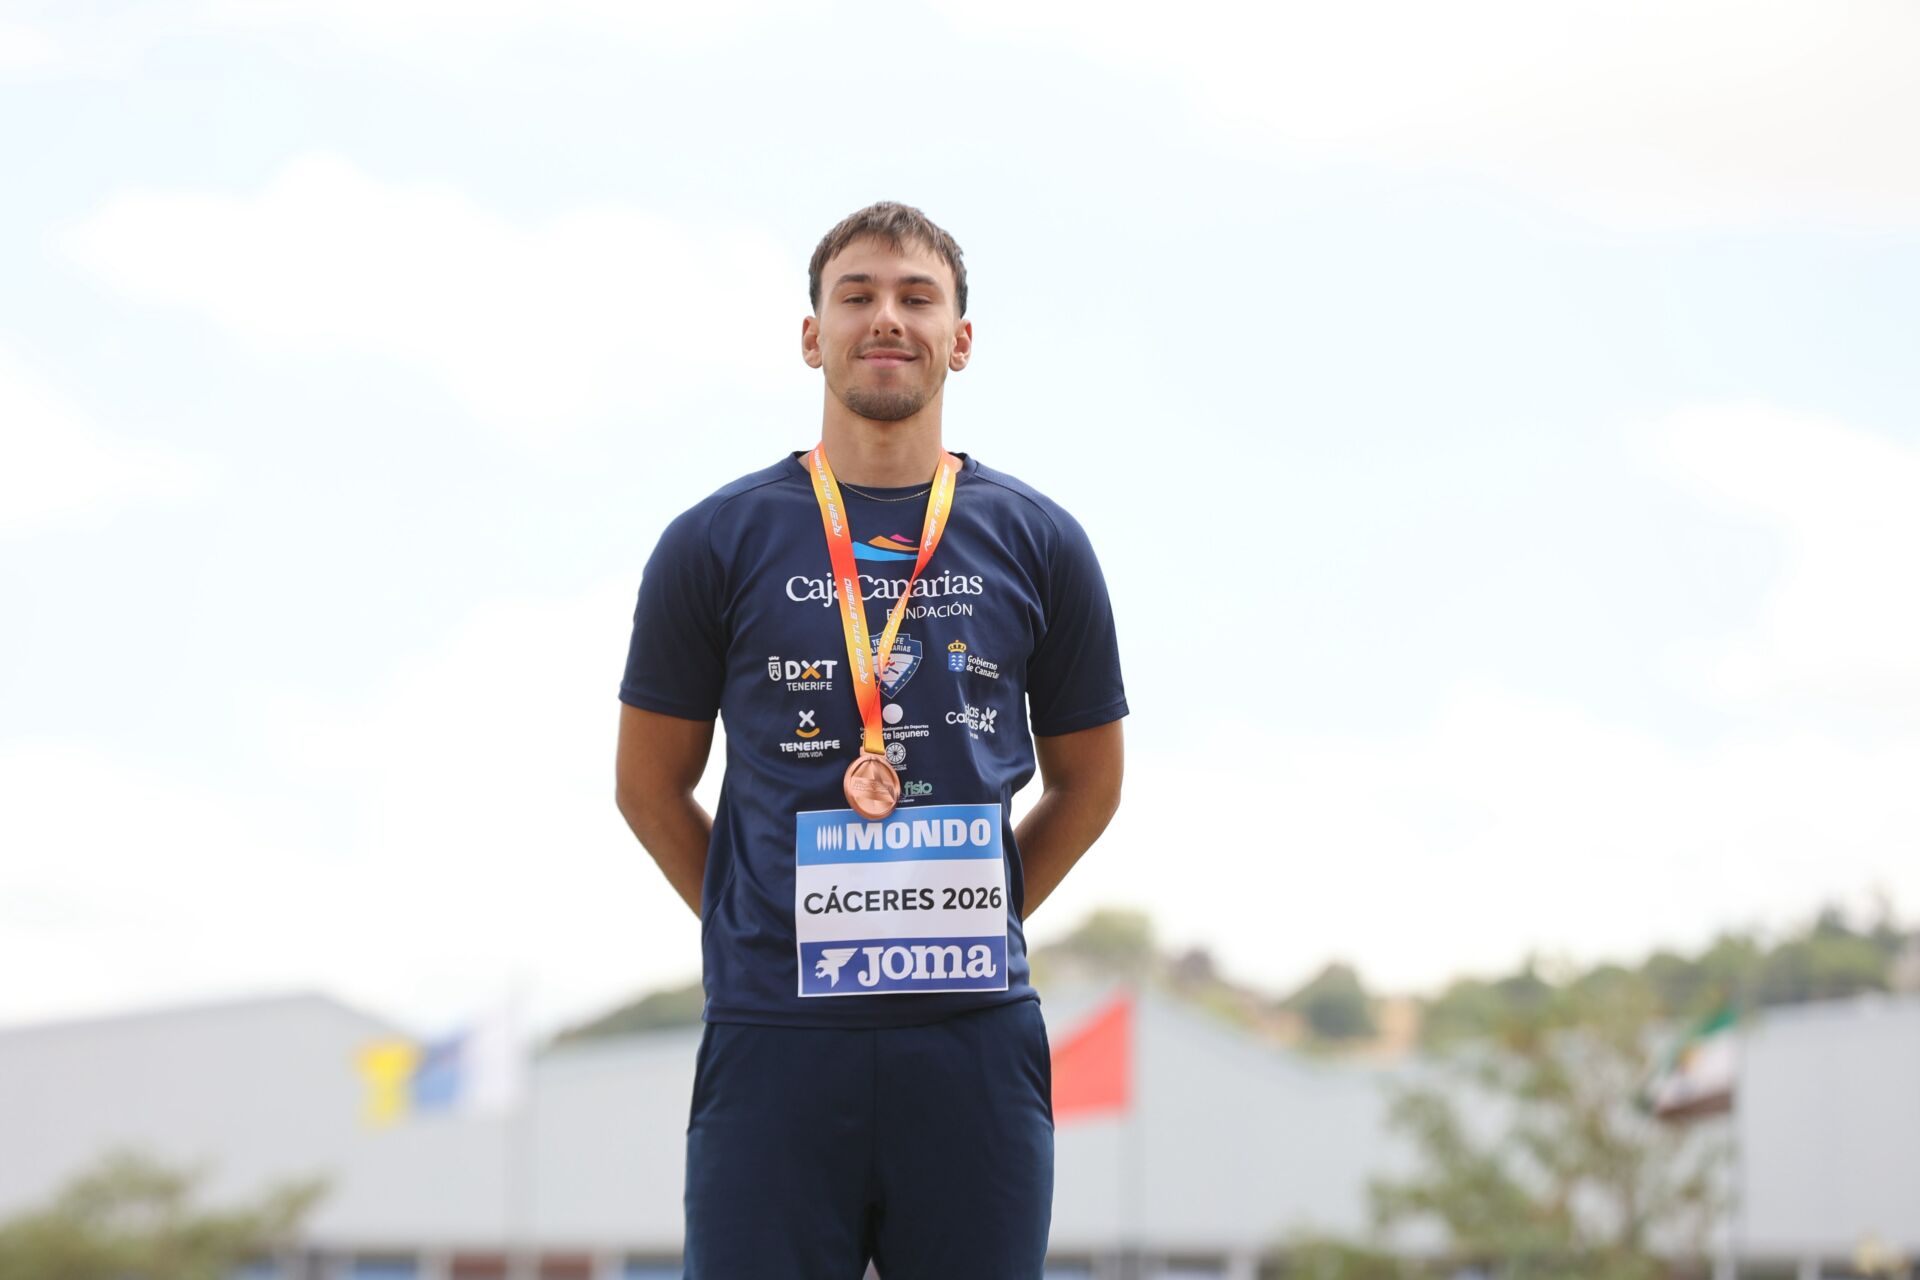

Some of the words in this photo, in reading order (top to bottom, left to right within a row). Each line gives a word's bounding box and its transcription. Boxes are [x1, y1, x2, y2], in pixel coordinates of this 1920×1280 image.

[886, 601, 974, 621] FNDACIÓN
[784, 659, 838, 680] DXT
[966, 662, 974, 672] de
[967, 654, 998, 671] Gobierno
[786, 681, 833, 692] TENERIFE
[892, 729, 930, 741] lagunero
[779, 739, 841, 753] TENERIFE
[904, 780, 933, 796] fisio
[846, 818, 991, 851] MONDO
[803, 885, 935, 915] CÁCERES
[942, 886, 1003, 910] 2026
